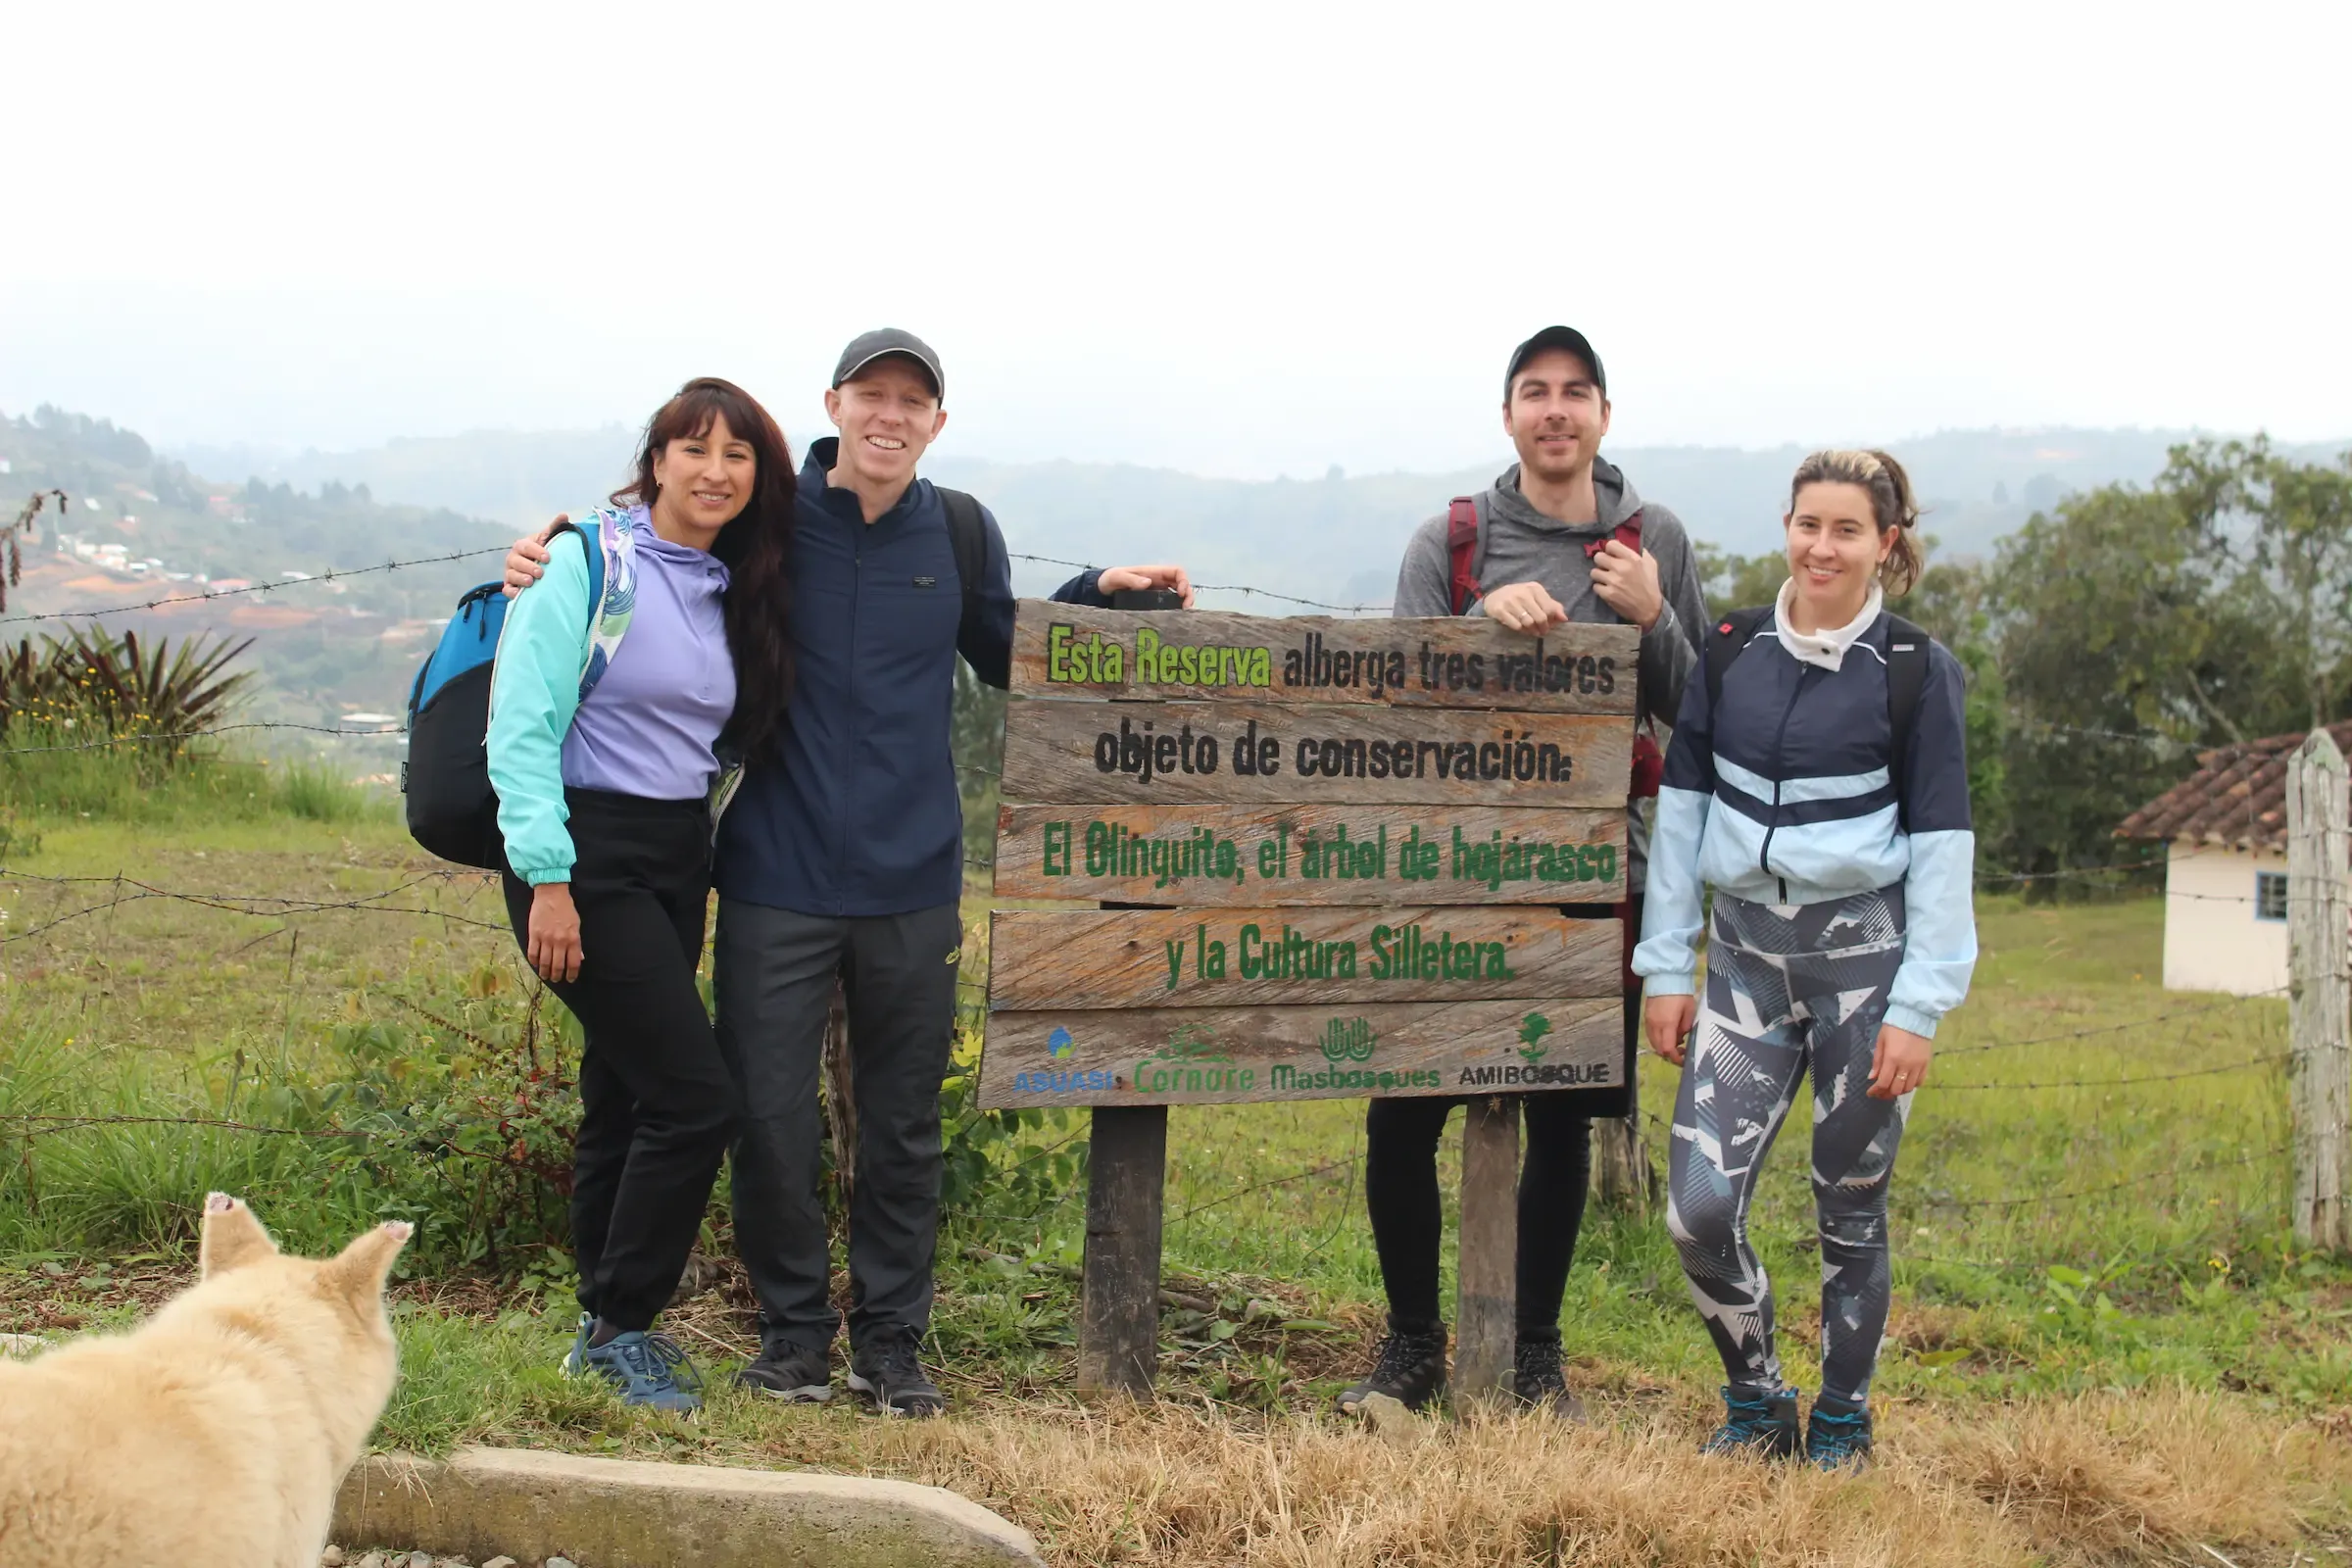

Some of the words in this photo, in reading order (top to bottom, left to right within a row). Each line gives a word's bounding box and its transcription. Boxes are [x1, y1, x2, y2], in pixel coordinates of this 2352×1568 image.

[1048, 622, 1124, 683] Esta
[1136, 626, 1272, 687] Reserva
[1283, 632, 1405, 699] alberga
[1418, 641, 1484, 691] tres
[1497, 638, 1615, 695] valores
[1095, 715, 1219, 784] objeto
[1233, 719, 1280, 776] de
[1296, 729, 1573, 783] conservación:
[1043, 821, 1071, 876] El
[1086, 820, 1245, 889] Olinguito,
[1258, 823, 1287, 879] el
[1300, 823, 1387, 879] árbol
[1398, 824, 1440, 881] de
[1452, 825, 1617, 892] hojarasco
[1166, 940, 1184, 990] y
[1197, 924, 1226, 980] la
[1239, 923, 1356, 979] Cultura
[1370, 924, 1516, 980] Silletera.
[1012, 1070, 1113, 1094] ASUASI
[1134, 1059, 1255, 1094] Cornare
[1459, 1062, 1610, 1085] AMIBOSQUE
